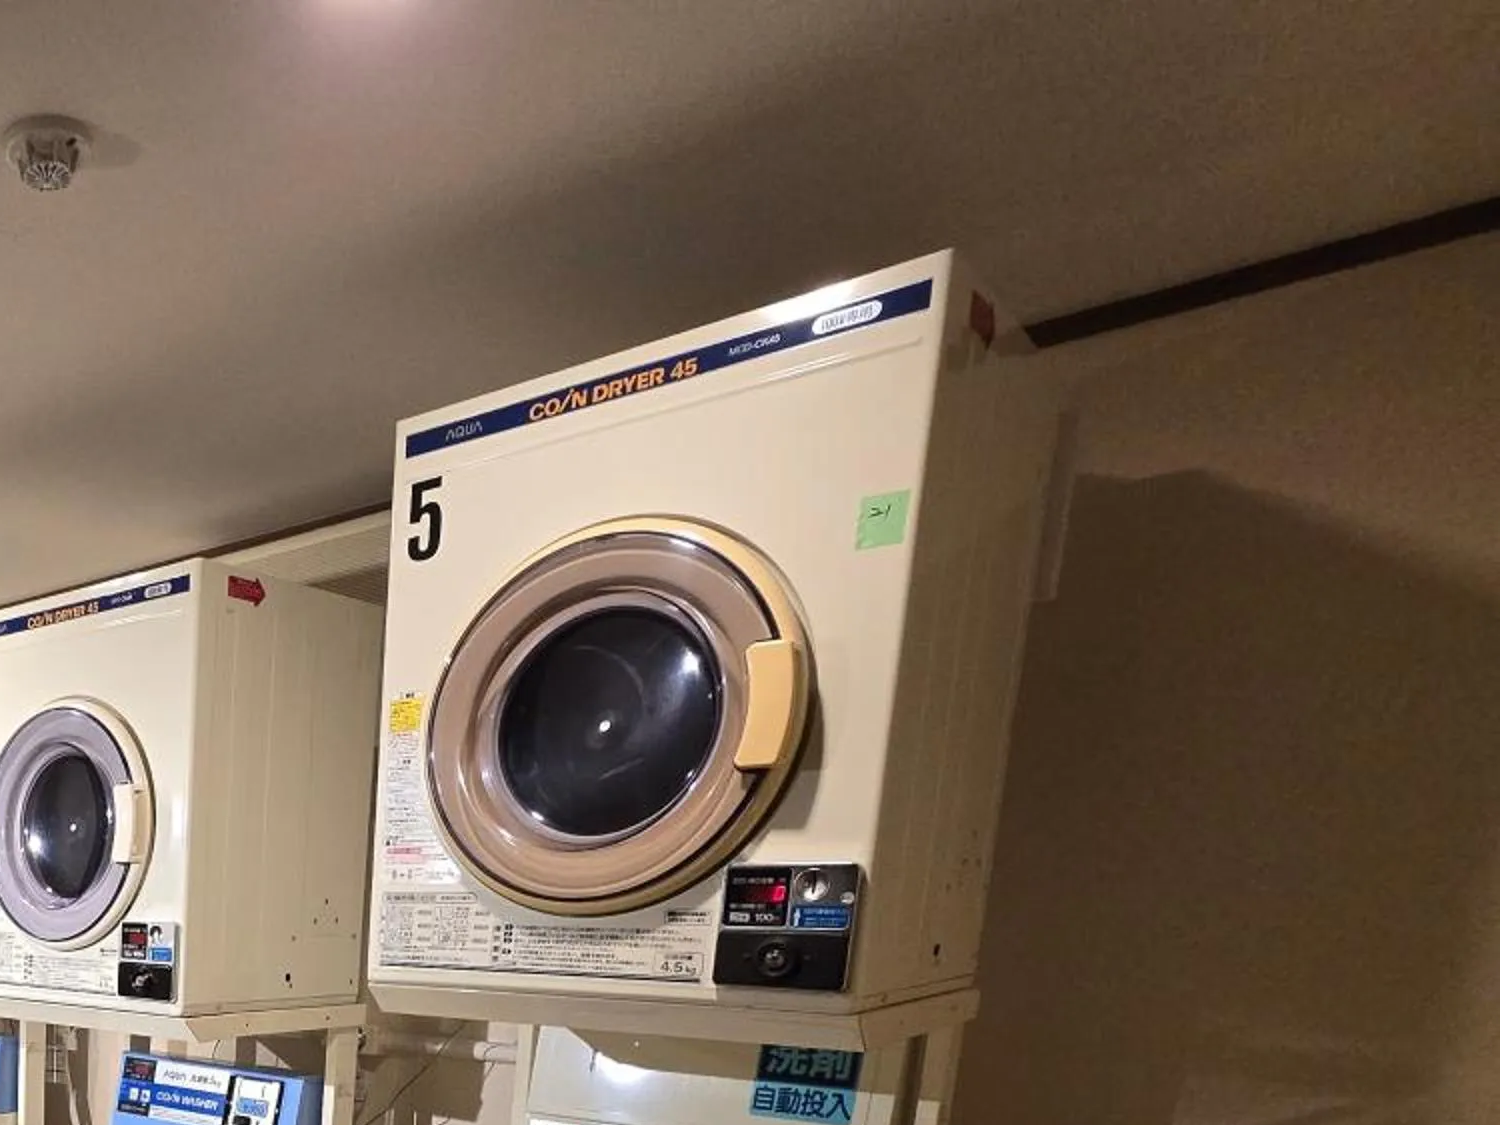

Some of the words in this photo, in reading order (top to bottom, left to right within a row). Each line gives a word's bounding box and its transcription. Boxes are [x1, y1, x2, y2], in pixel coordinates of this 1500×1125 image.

[445, 421, 483, 441] AQUA
[592, 367, 664, 402] DRYER
[670, 356, 698, 382] 45
[407, 475, 443, 561] 5
[754, 1084, 851, 1120] 自動投入
